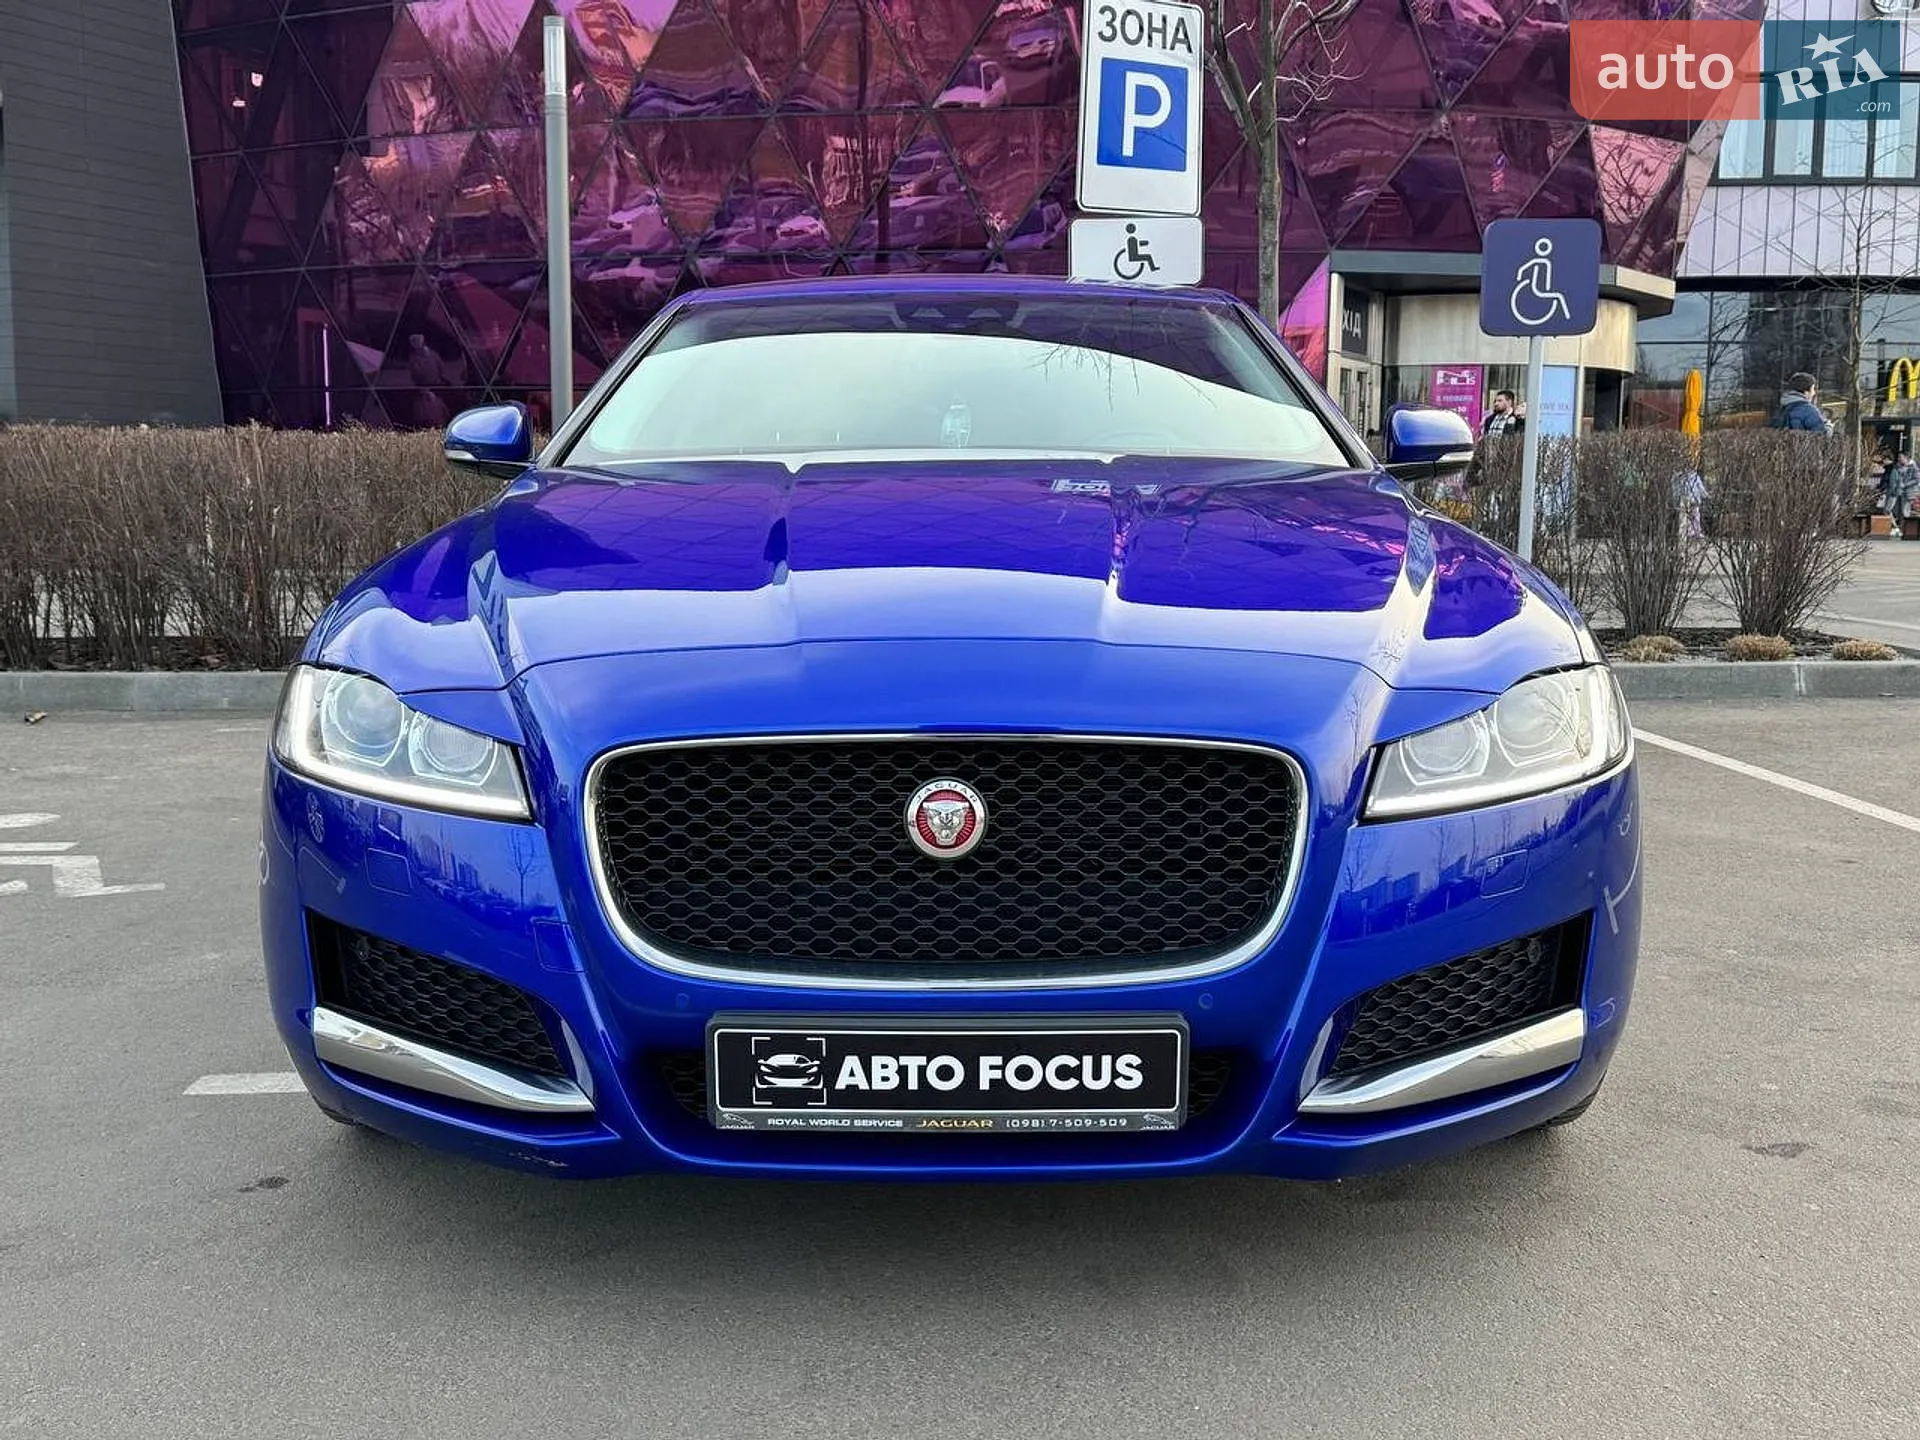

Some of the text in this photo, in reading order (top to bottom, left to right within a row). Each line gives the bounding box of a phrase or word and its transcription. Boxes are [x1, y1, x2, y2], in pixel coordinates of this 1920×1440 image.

[1097, 6, 1194, 54] ЗОНА
[1122, 70, 1172, 158] P
[835, 1054, 1144, 1091] АВТО FOCUS
[767, 1118, 904, 1128] ROYAL WORLD SERVICE
[916, 1118, 994, 1128] JAGUAR
